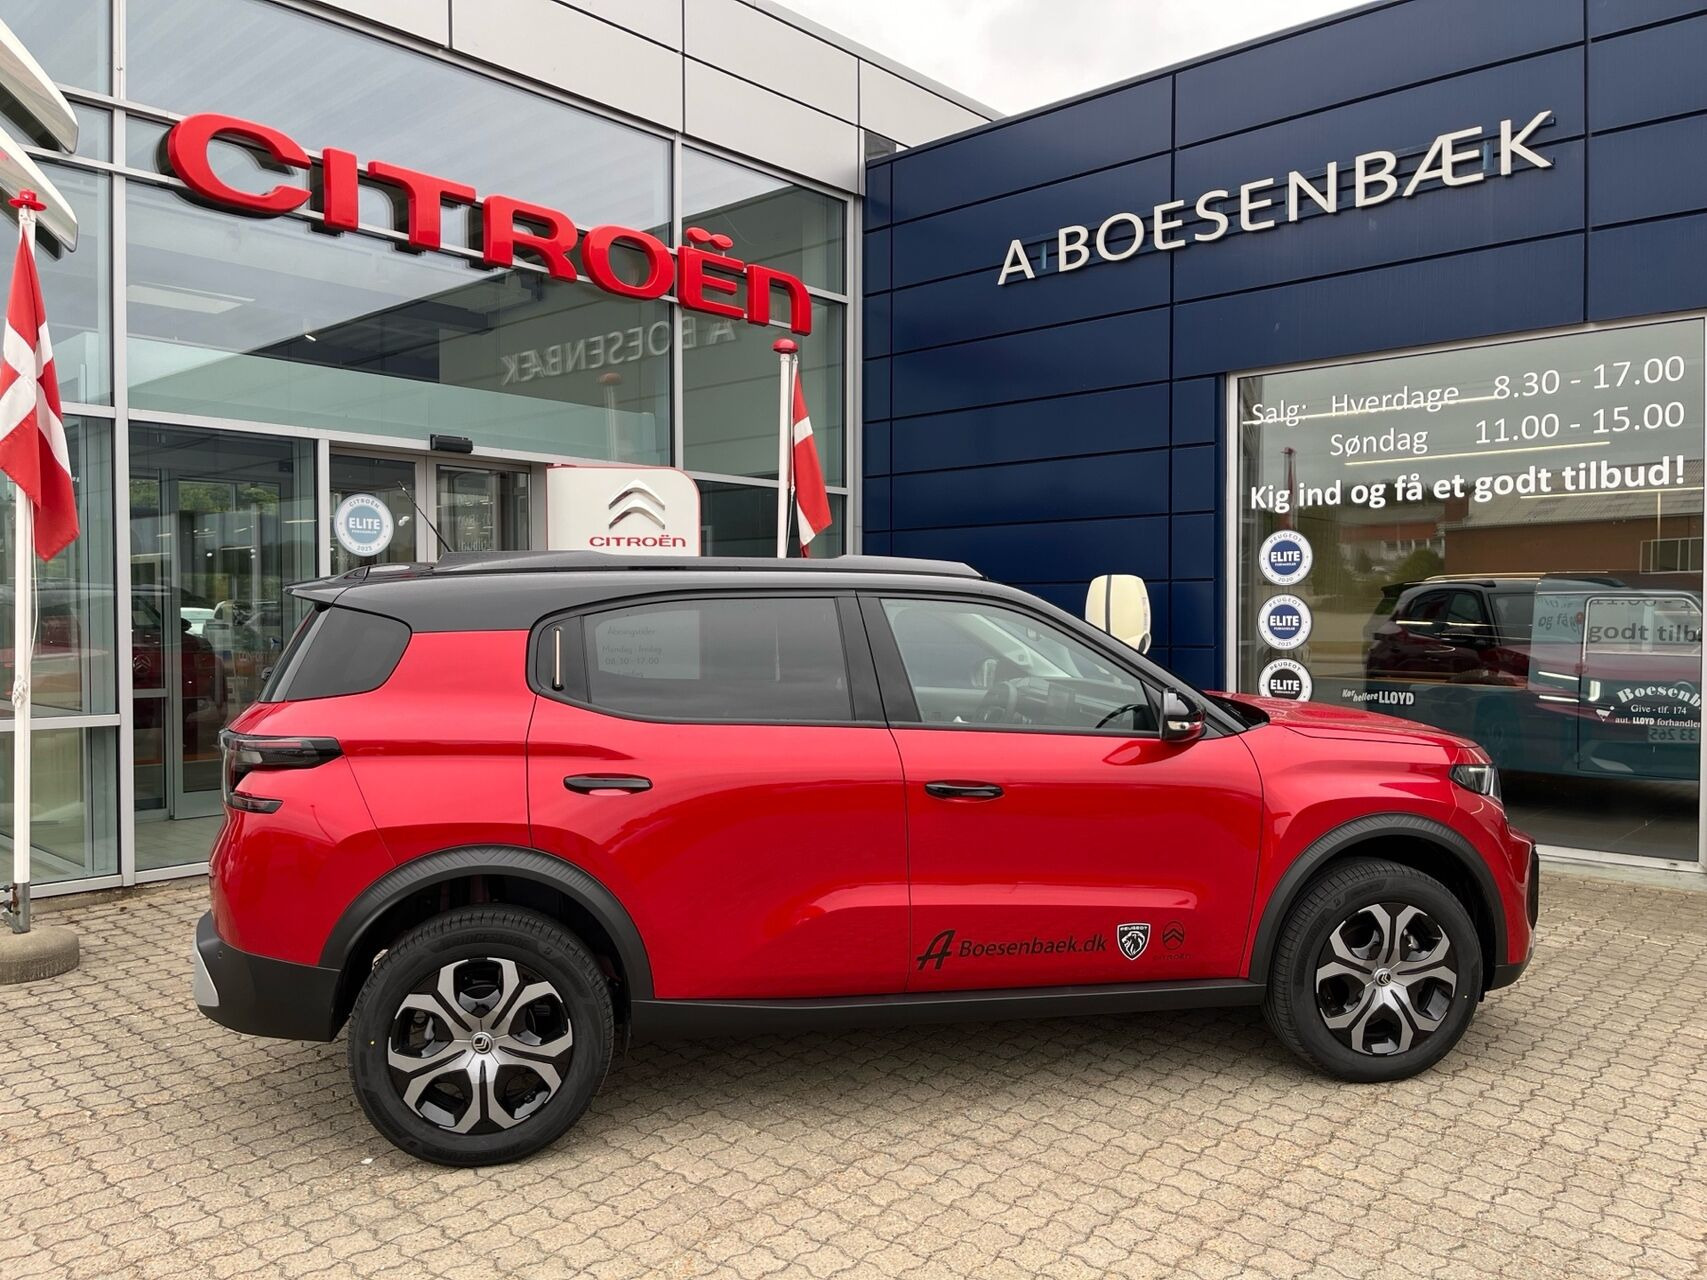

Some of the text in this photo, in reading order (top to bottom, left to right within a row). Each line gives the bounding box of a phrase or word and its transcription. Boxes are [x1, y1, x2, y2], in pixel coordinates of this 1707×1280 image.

[998, 110, 1554, 286] A BOESENBÆK
[167, 111, 813, 336] CITROËN
[1252, 400, 1307, 427] Salg:
[1331, 385, 1460, 417] Hverdage
[1493, 369, 1560, 400] 8.30
[1593, 355, 1685, 389] 17.00
[1330, 427, 1429, 457] Søndag
[1475, 413, 1560, 444] 11.00
[1593, 401, 1685, 434] 15.00
[1251, 454, 1685, 514] Kig ind og få et godt tilbud!
[349, 517, 381, 530] ELITE
[589, 534, 687, 548] CITROËN
[1270, 551, 1301, 562] ELITE
[1269, 615, 1300, 627] ELITE
[1269, 661, 1302, 672] PEUGEOT
[1270, 679, 1300, 691] ELITE
[1378, 690, 1415, 705] LLOYD
[1630, 704, 1651, 713] Give
[1673, 706, 1687, 715] 174
[1632, 716, 1655, 725] LLOYD
[958, 934, 1109, 958] Boesenbaek.dk
